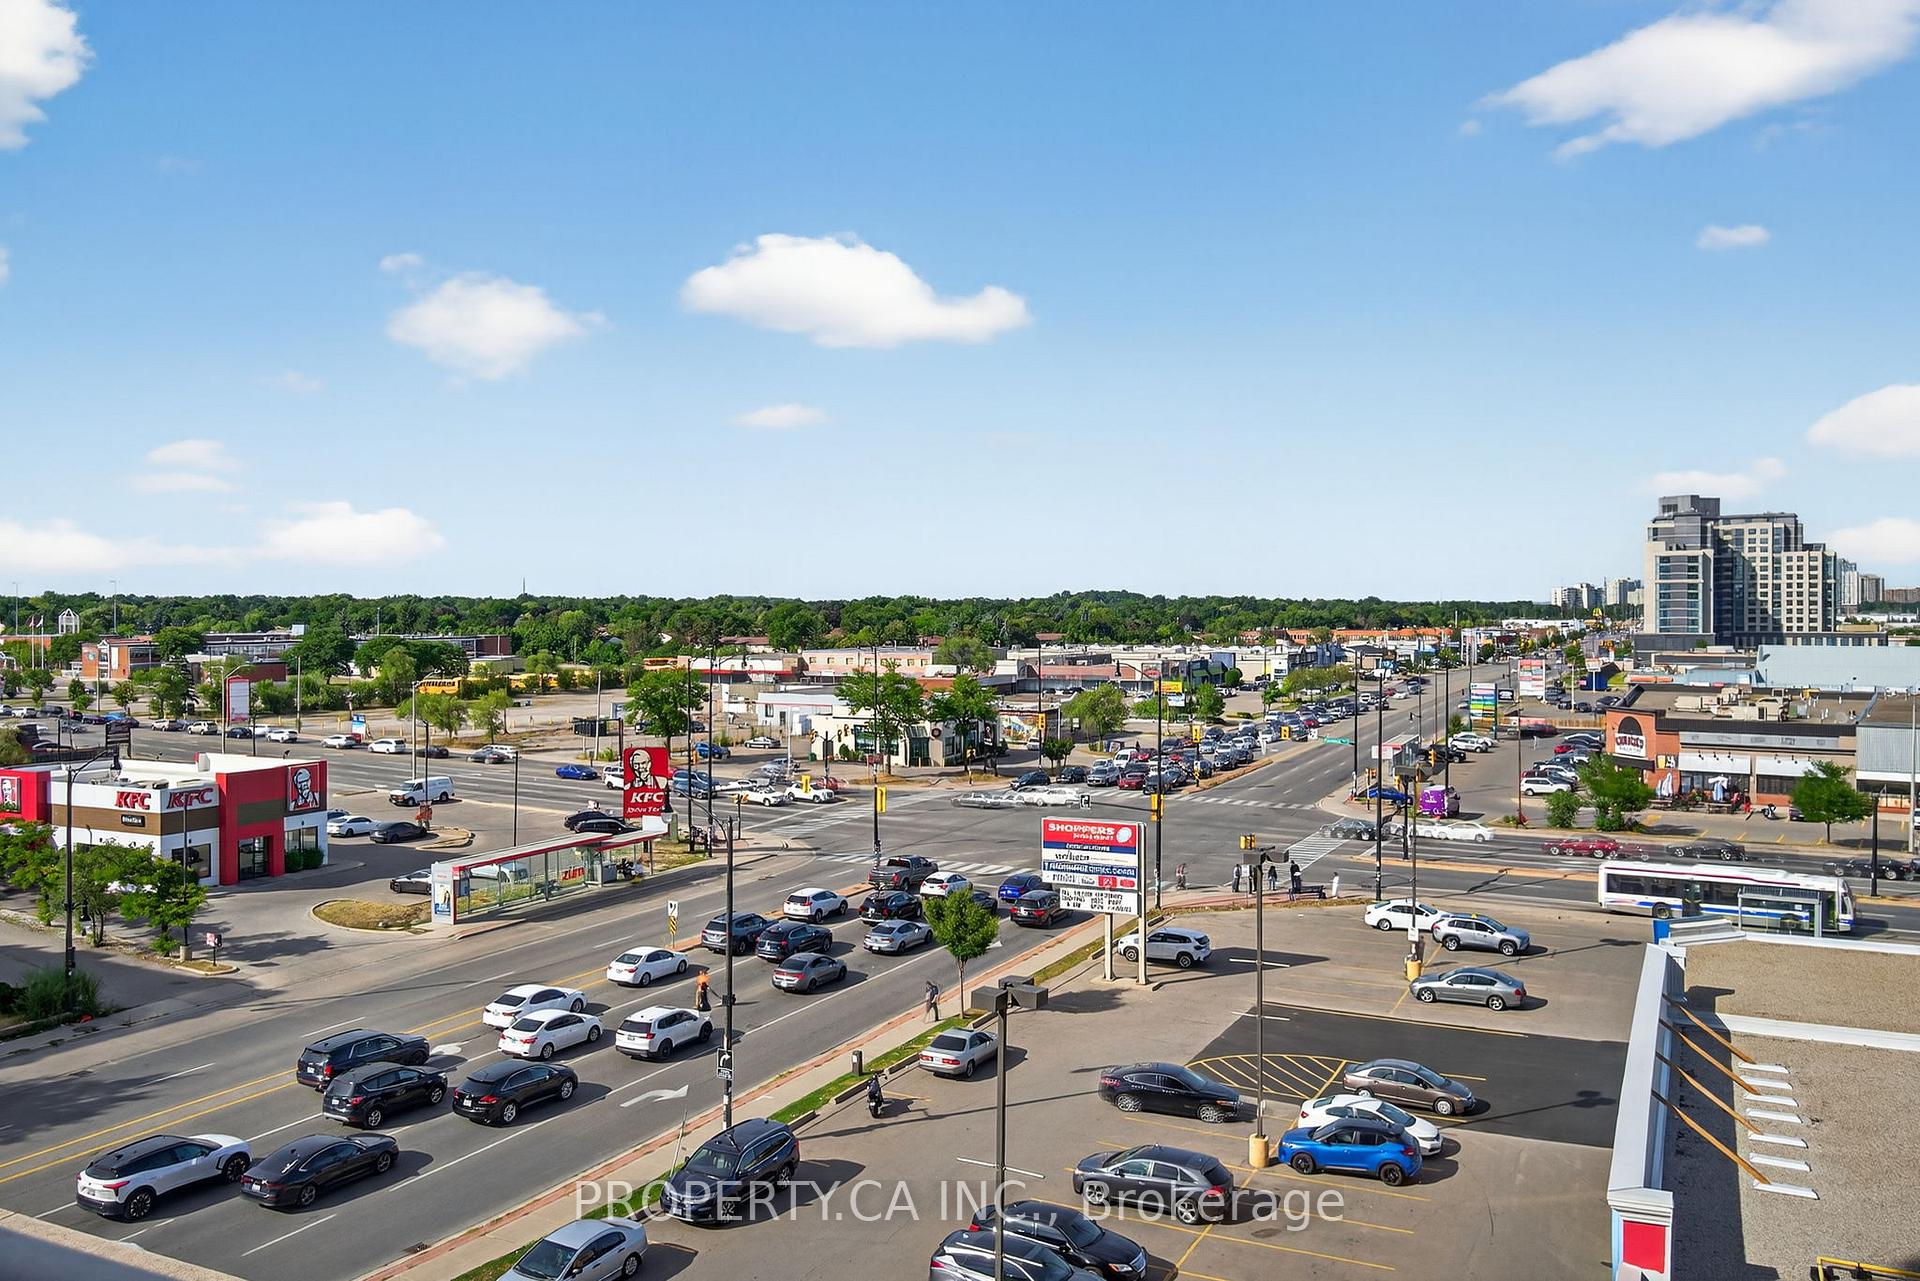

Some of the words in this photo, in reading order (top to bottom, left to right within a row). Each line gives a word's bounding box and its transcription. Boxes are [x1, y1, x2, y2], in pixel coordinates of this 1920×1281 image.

[115, 791, 151, 810] KFC
[167, 788, 214, 809] KFC
[630, 791, 664, 803] KFC
